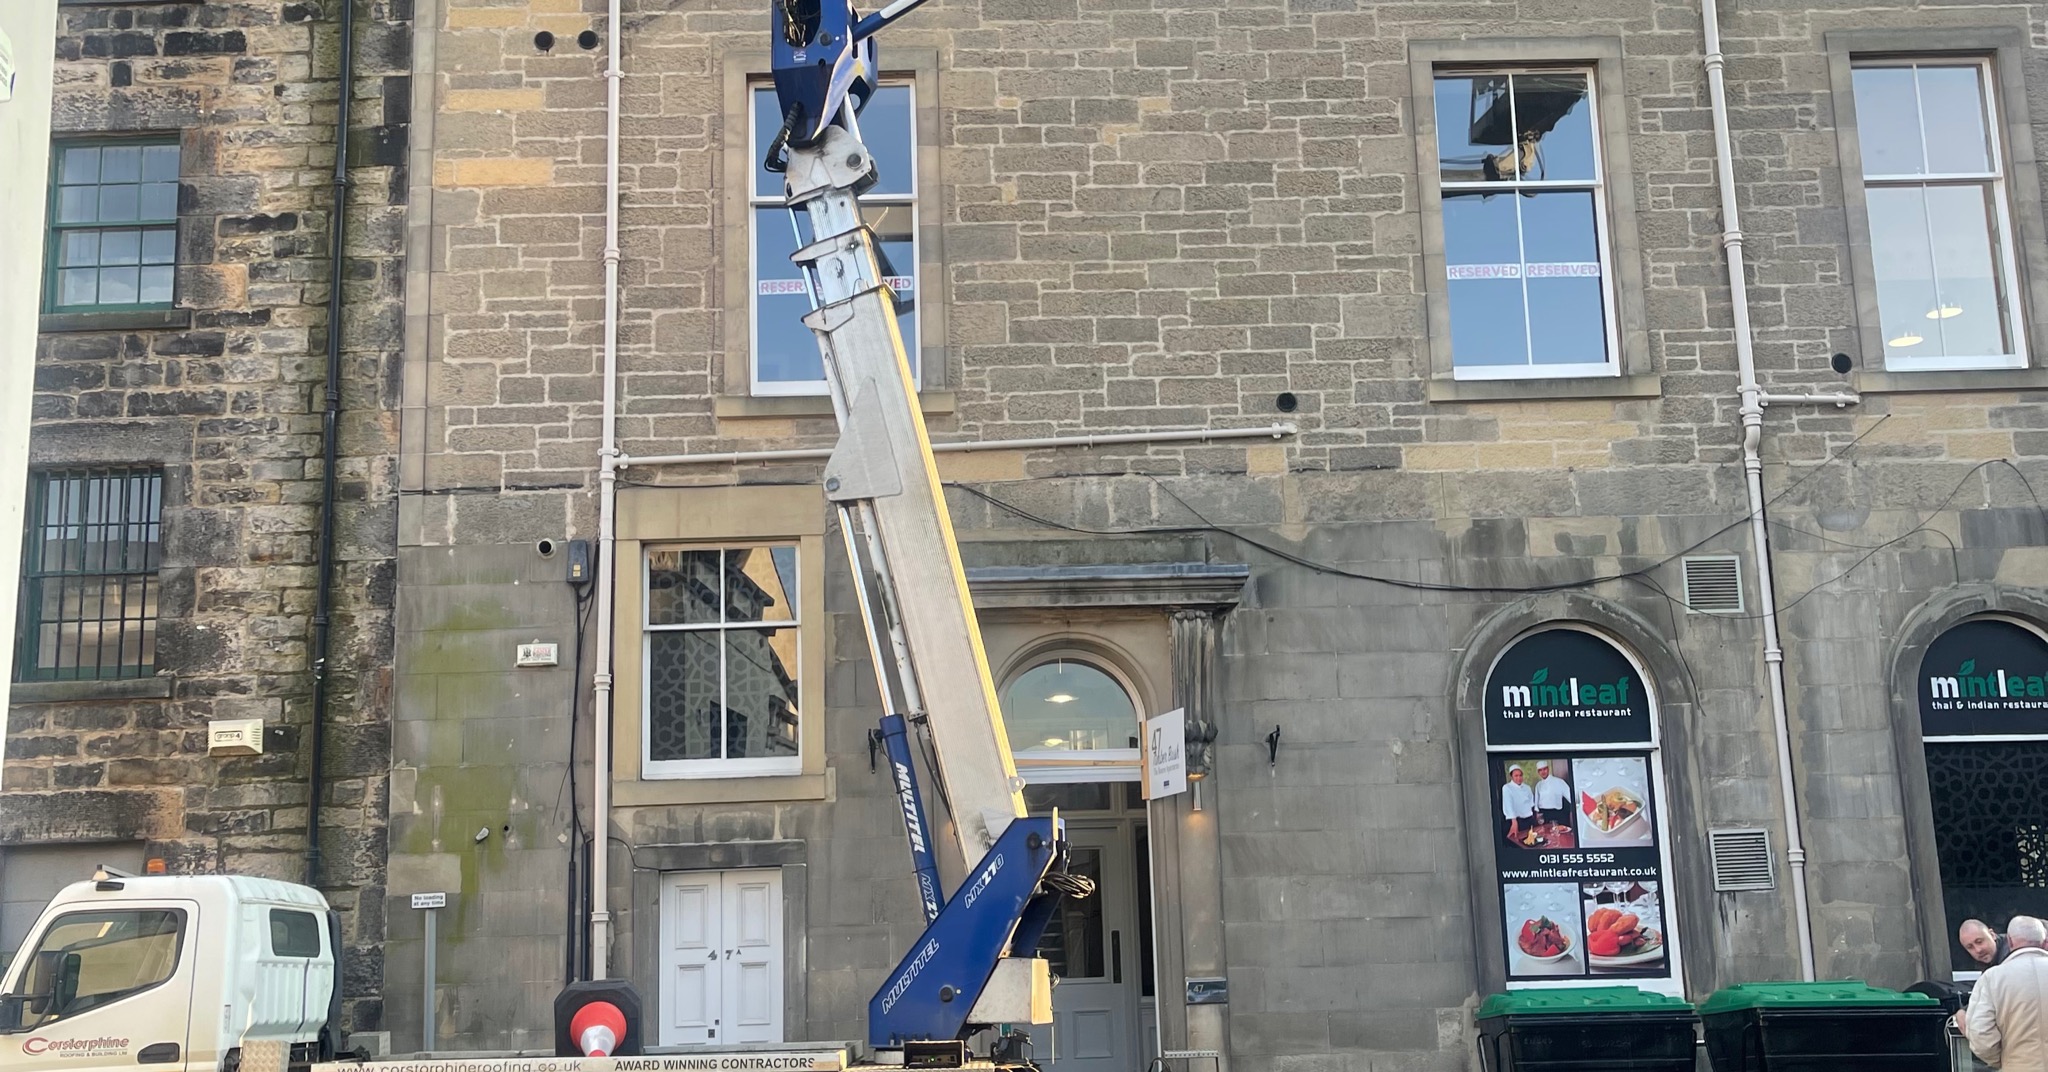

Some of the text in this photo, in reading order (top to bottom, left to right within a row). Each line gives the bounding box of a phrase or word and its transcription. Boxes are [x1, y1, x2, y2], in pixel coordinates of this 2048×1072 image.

[1449, 264, 1598, 278] RESERVED RESERVED
[760, 281, 805, 293] RESER
[1930, 669, 2048, 698] mintlea
[1503, 676, 1629, 707] mintleaf
[1932, 701, 1952, 709] thai
[1956, 701, 1964, 709] &
[1967, 700, 2000, 709] indian
[1503, 708, 1632, 718] thai & indian restaurant
[896, 762, 926, 853] MULTITEL
[1539, 853, 1615, 864] 0131 555 5552
[1502, 866, 1657, 878] www.mintleafrestaurant.co.uk
[964, 853, 1004, 909] MX270
[921, 873, 939, 922] MX27
[882, 938, 940, 1014] MULTITEL
[1193, 984, 1204, 993] 47
[22, 1037, 130, 1056] Corstorphine
[338, 1060, 582, 1072] wwwcorstorphineroofing.co.uk
[615, 1058, 815, 1071] AWARD WINNING CONTRACTORS
